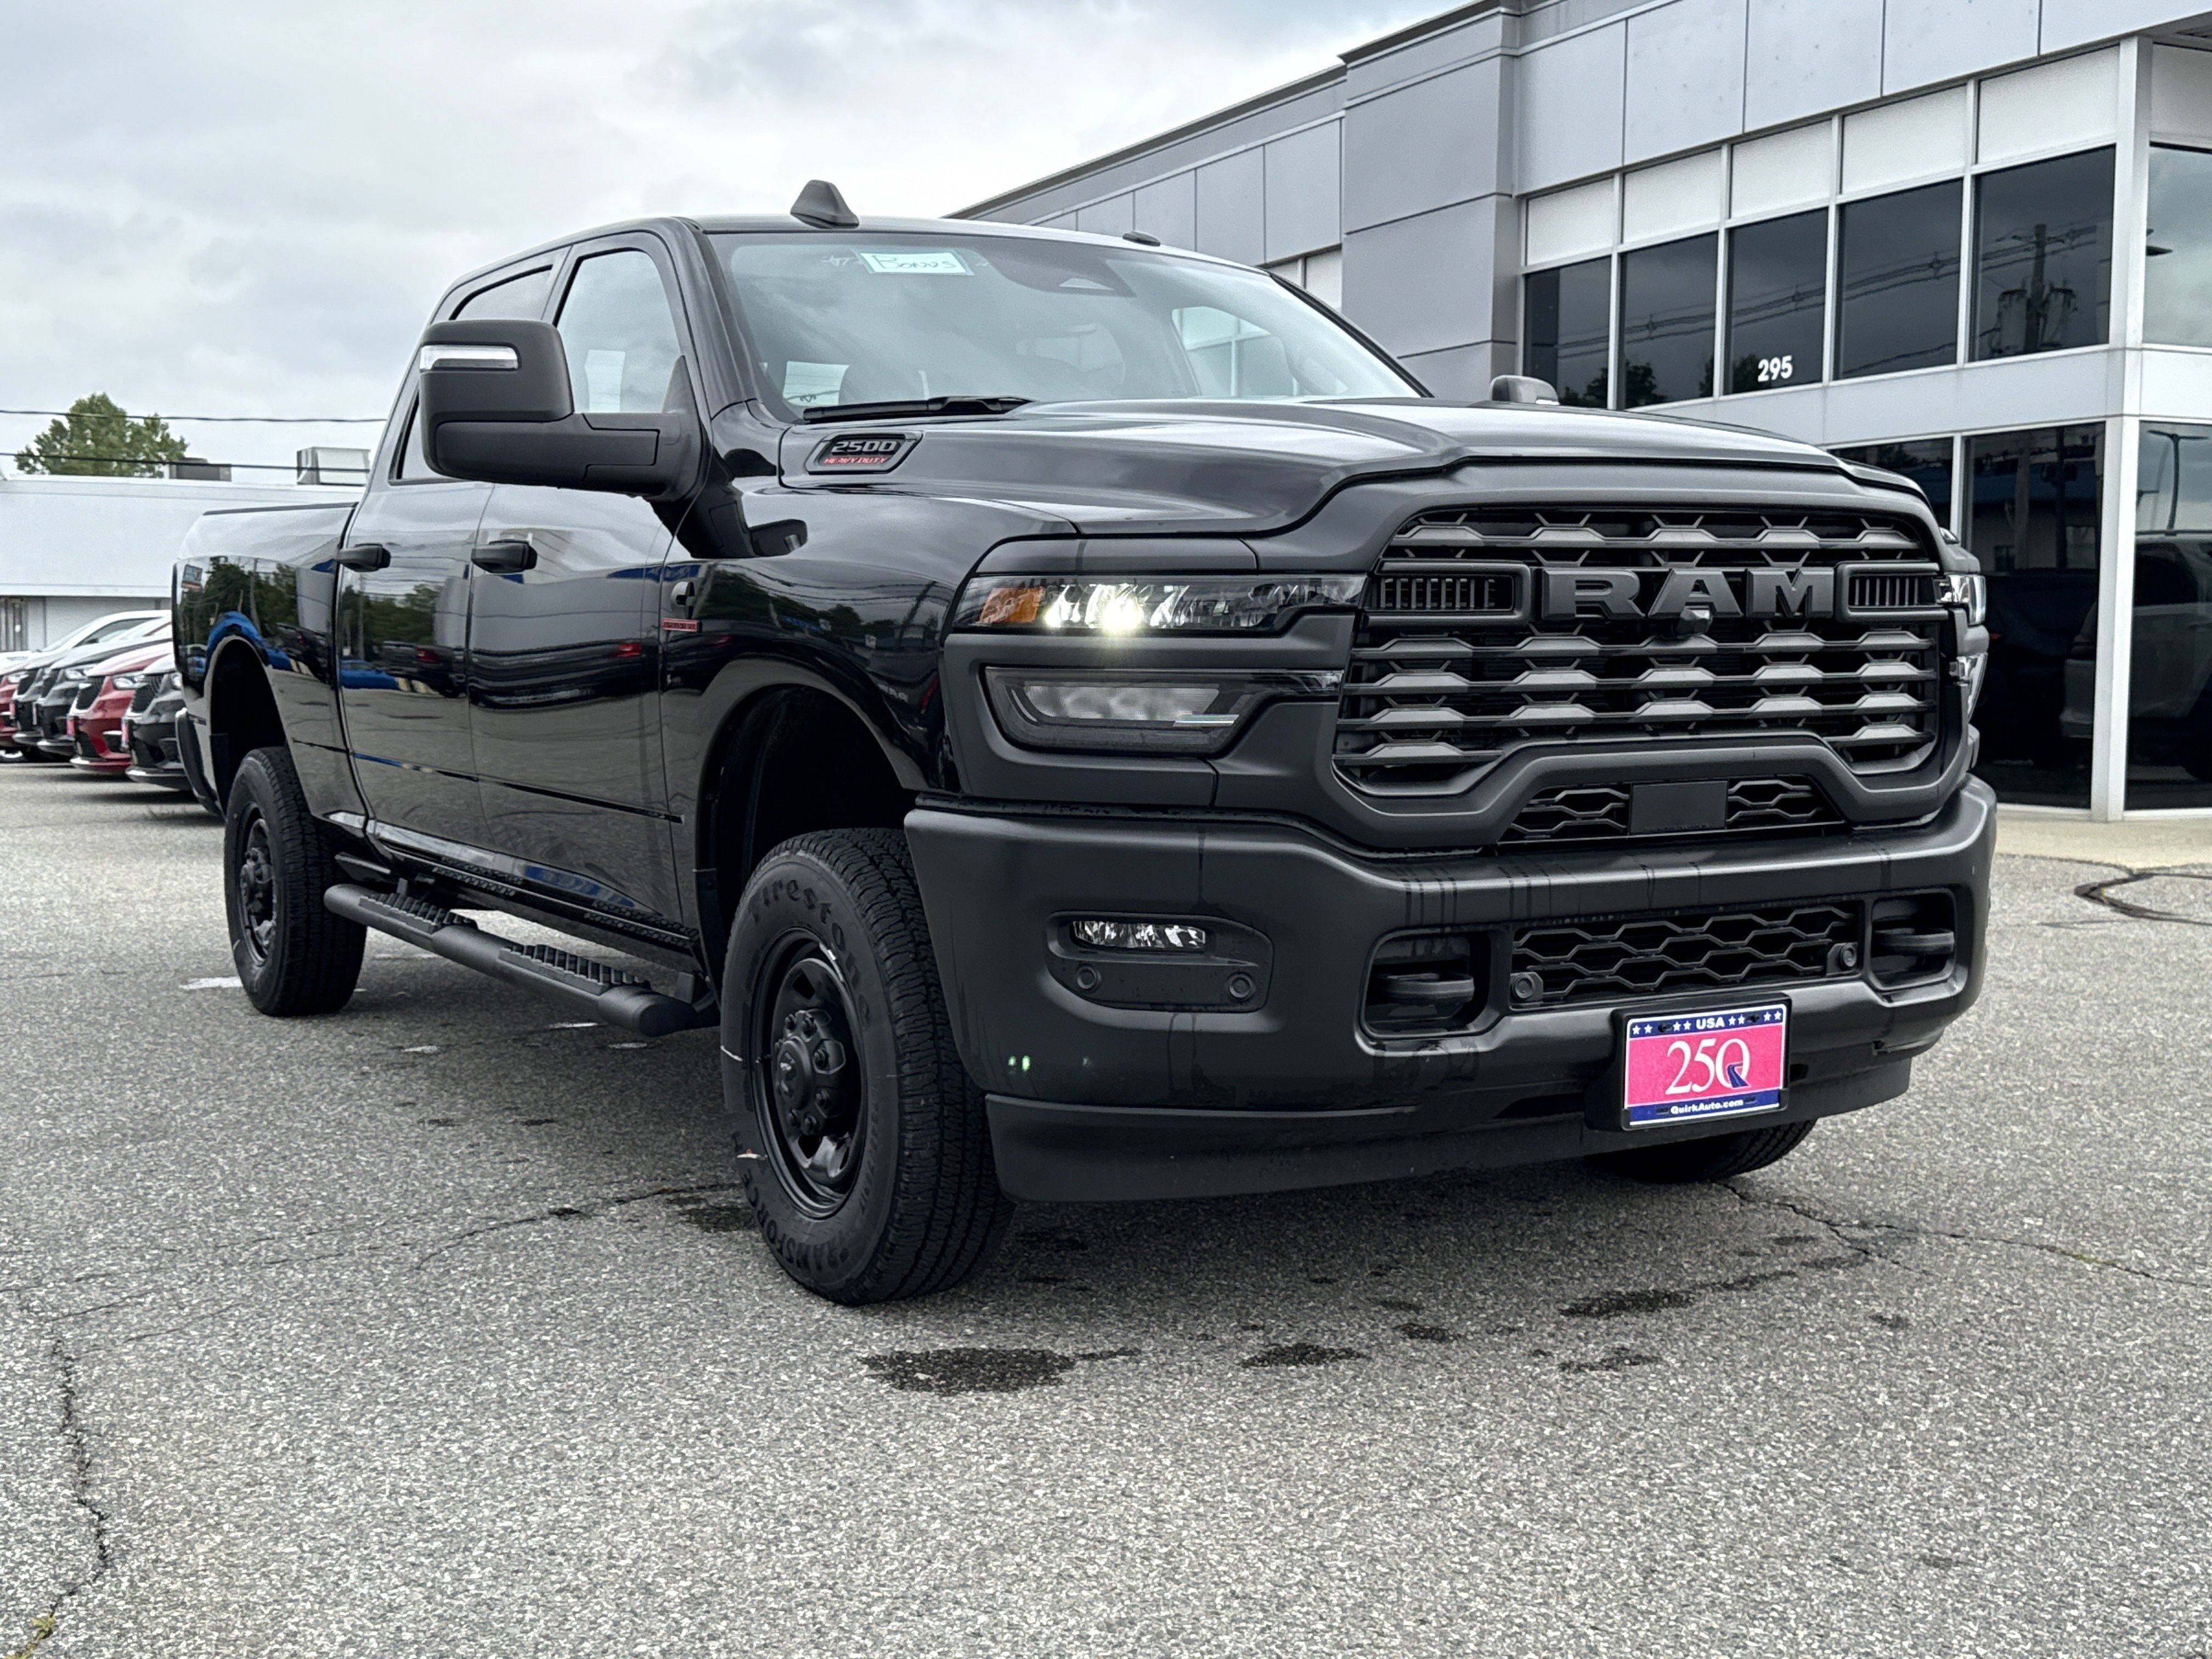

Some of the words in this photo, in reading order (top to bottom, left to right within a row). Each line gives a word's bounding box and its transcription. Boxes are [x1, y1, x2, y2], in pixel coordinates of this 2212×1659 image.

[1757, 354, 1793, 382] 295
[831, 441, 897, 454] 2500
[1542, 568, 1833, 619] RAM
[1696, 1017, 1725, 1030] USA
[1671, 1099, 1743, 1115] QuirkAuto.com
